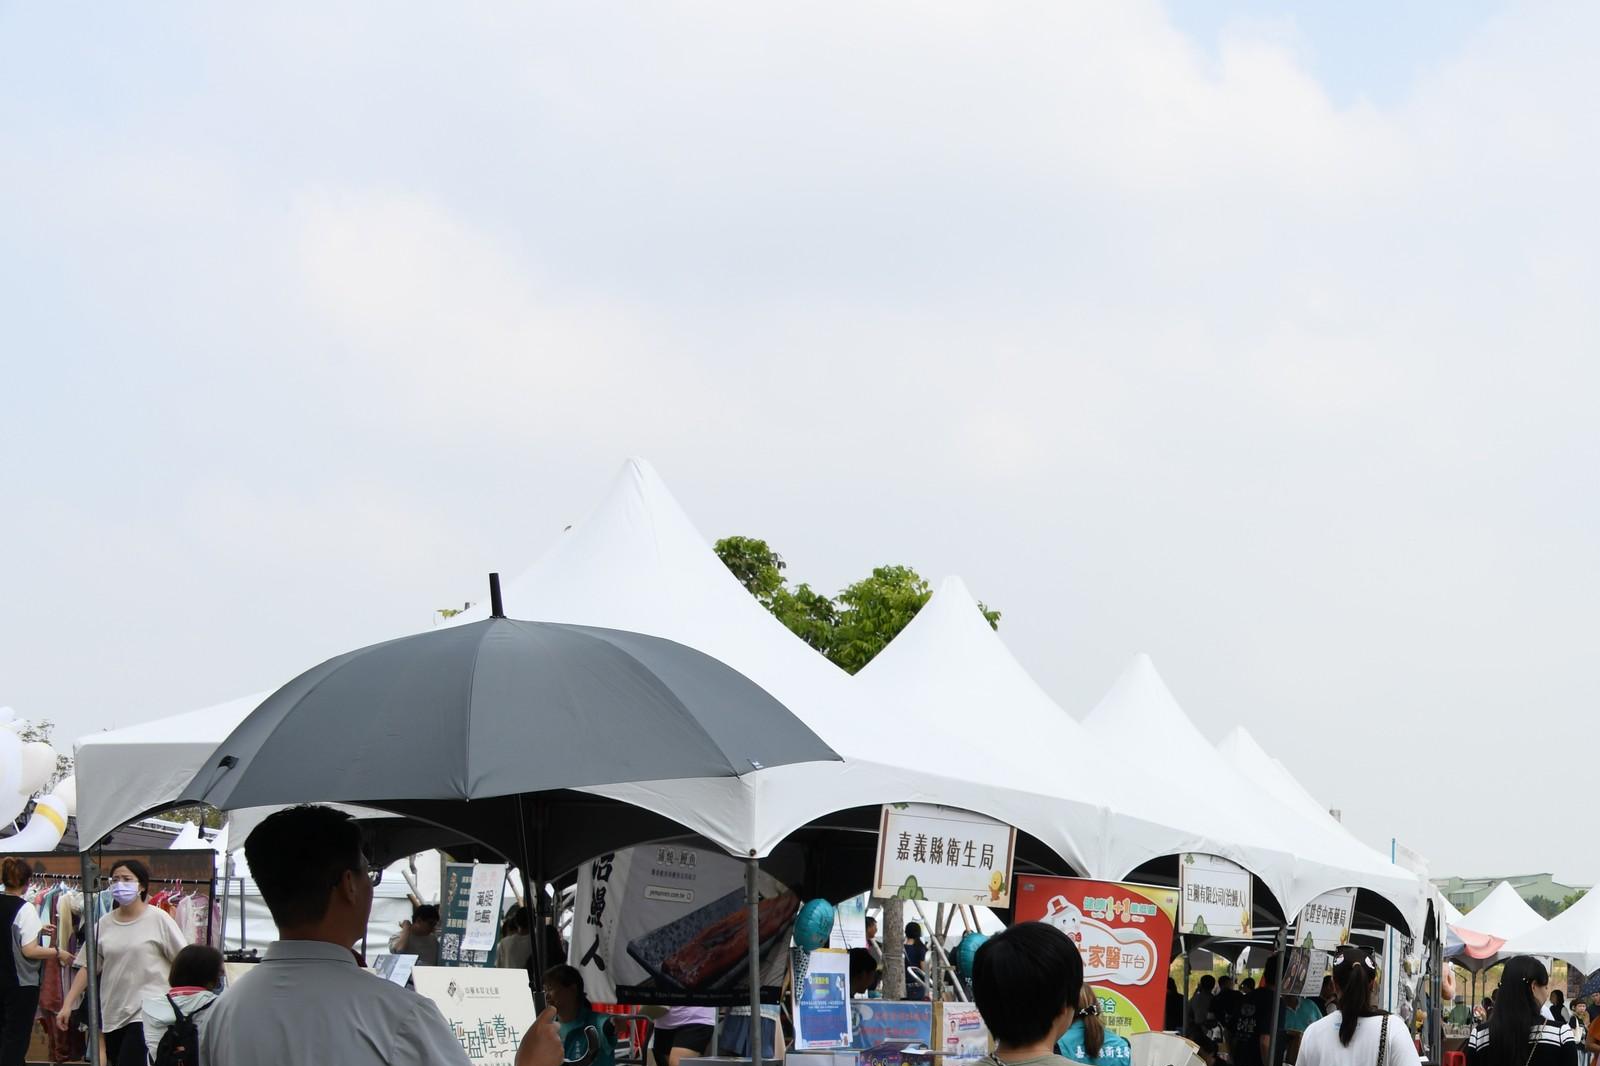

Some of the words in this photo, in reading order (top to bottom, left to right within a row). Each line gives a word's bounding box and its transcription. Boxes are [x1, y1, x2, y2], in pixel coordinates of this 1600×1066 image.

[895, 830, 995, 871] 嘉義縣衛生局
